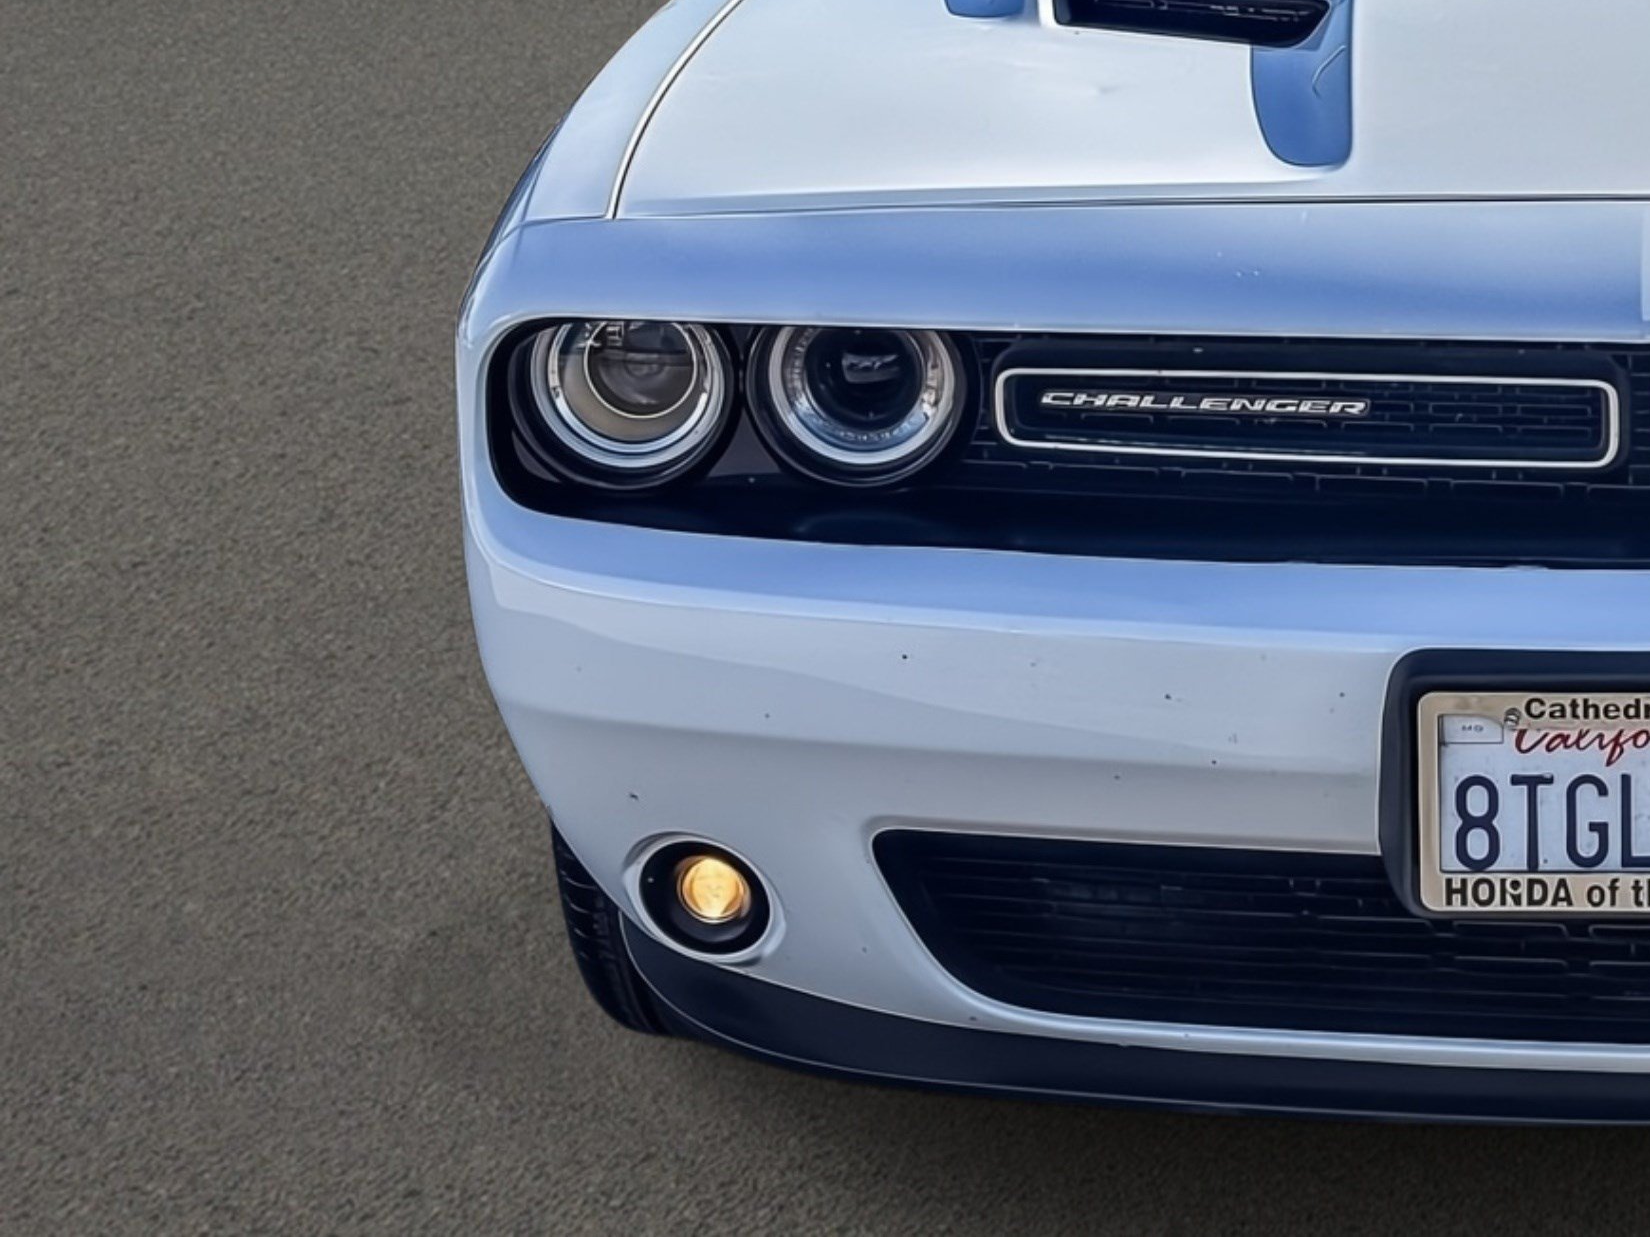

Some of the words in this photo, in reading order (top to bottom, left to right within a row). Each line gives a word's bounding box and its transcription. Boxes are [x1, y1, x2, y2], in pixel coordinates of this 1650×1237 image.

[1040, 390, 1368, 415] CHALLENGER
[1444, 877, 1574, 909] HONDA
[1586, 877, 1622, 909] of
